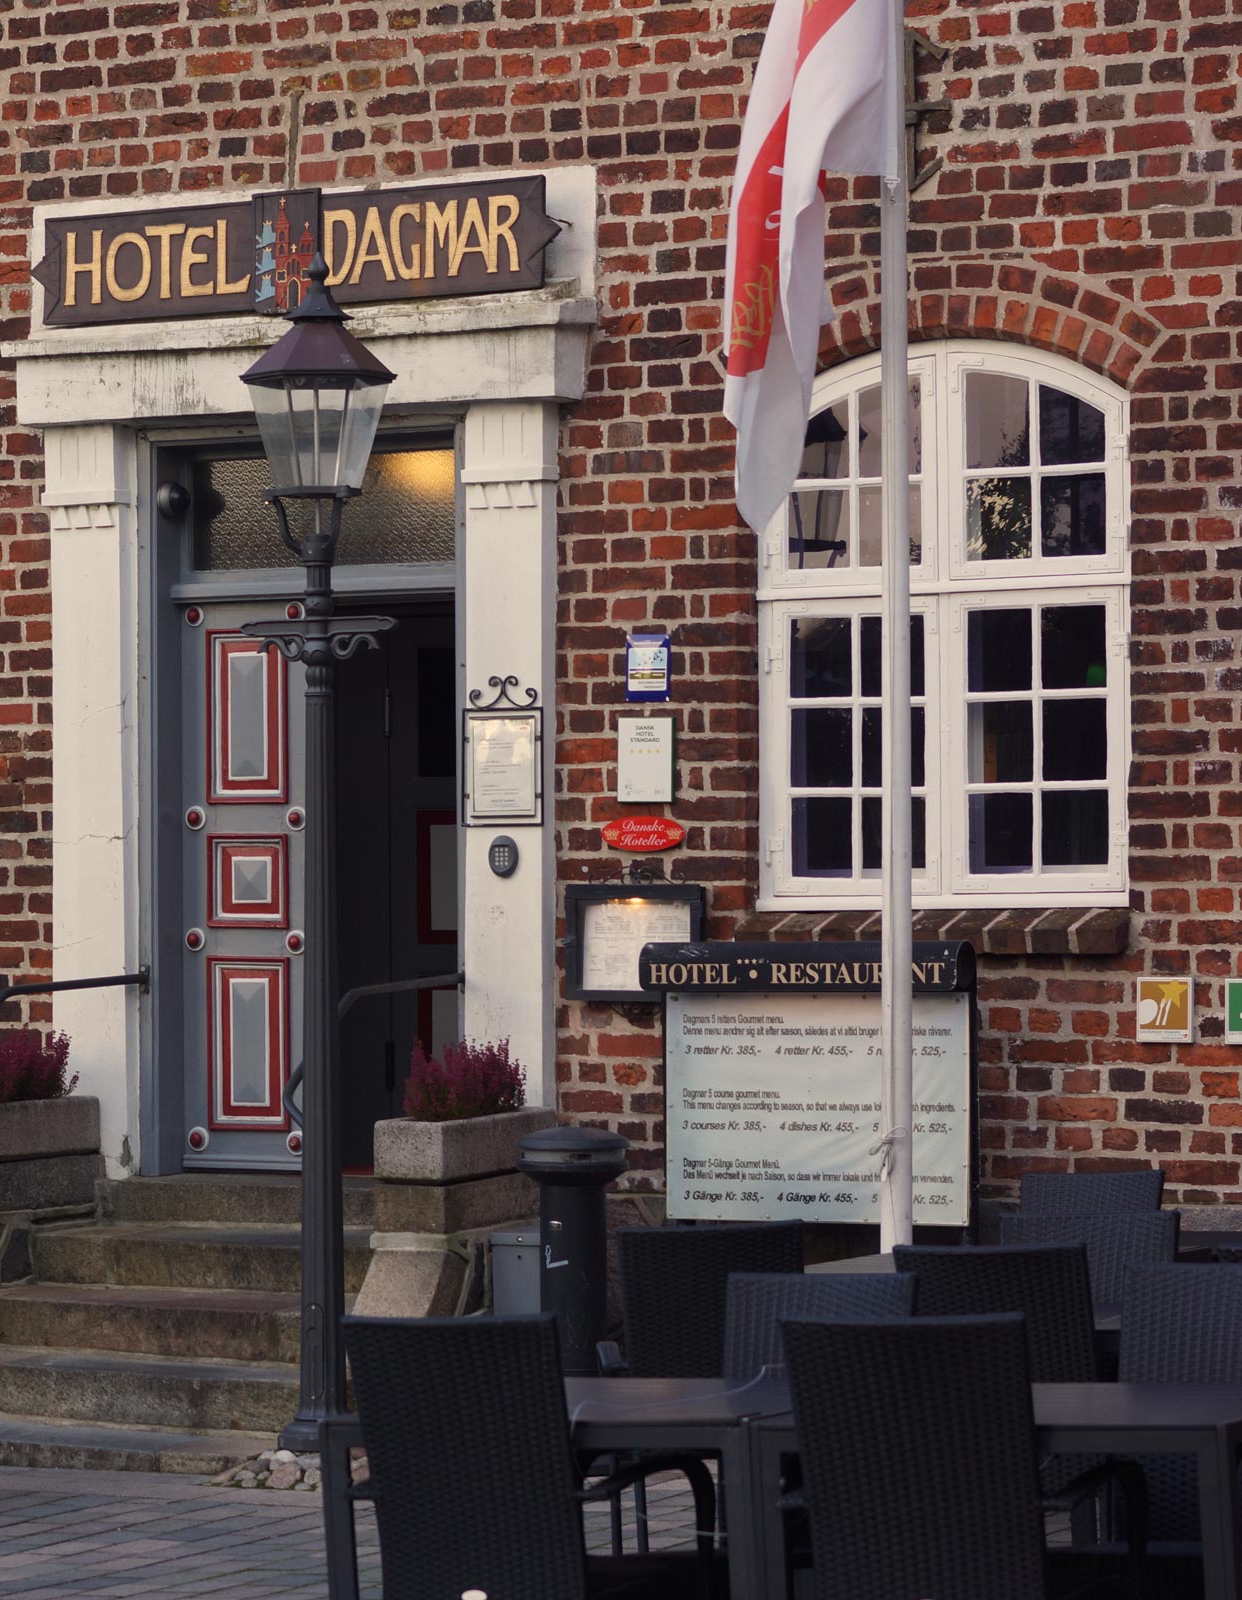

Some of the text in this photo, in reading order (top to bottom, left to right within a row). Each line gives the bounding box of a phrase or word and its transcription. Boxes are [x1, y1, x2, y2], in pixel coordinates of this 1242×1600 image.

[63, 194, 521, 306] HOTEL DAGMAR
[622, 819, 665, 832] Danske
[619, 833, 667, 846] Hoteller
[649, 962, 945, 985] HOTEL RESTAURNT
[682, 1014, 784, 1026] Dagmars 5 retters Gourmet menu.
[683, 1026, 702, 1035] Denne
[704, 1027, 721, 1035] menu
[722, 1026, 745, 1036] ændrer
[746, 1026, 755, 1038] sig
[756, 1026, 764, 1036] alt
[765, 1026, 779, 1036] efter
[781, 1027, 803, 1037] sæson,
[805, 1025, 829, 1036] således
[830, 1026, 837, 1036] at
[837, 1026, 843, 1036] vi
[844, 1026, 857, 1036] altid
[858, 1026, 879, 1038] bruger
[928, 1025, 953, 1036] råvarer.
[685, 1045, 692, 1055] 3
[693, 1045, 719, 1055] retter
[720, 1045, 734, 1055] Kr.
[736, 1045, 761, 1056] 385,-
[775, 1045, 782, 1055] 4
[783, 1046, 810, 1056] retter
[811, 1045, 825, 1056] Kr.
[828, 1046, 853, 1057] 455,-
[867, 1046, 874, 1056] 5
[920, 1046, 947, 1057] 525,-
[682, 1088, 780, 1101] Dagmar 5 course gourmet menu.
[683, 1100, 696, 1110] This
[697, 1101, 714, 1110] menu
[715, 1101, 741, 1112] changes
[742, 1100, 773, 1113] according
[773, 1101, 780, 1111] to
[781, 1102, 805, 1112] season,
[806, 1103, 814, 1111] so
[815, 1101, 828, 1111] that
[828, 1103, 837, 1111] we
[838, 1101, 860, 1114] always
[861, 1103, 872, 1112] use
[920, 1102, 956, 1114] ingredients.
[682, 1120, 953, 1134] 3 courses Kr. 385,- 4 dishes Kr. 455,- 5 Kr. 525,-
[683, 1157, 780, 1170] Dagmar 5-Gänge Gourmet Menü.
[683, 1169, 695, 1179] Das
[696, 1169, 713, 1180] Menü
[714, 1170, 740, 1180] wechselt
[740, 1171, 746, 1182] je
[748, 1170, 763, 1180] nach
[764, 1170, 786, 1182] Saison,
[787, 1173, 795, 1181] so
[796, 1171, 811, 1181] dass
[811, 1171, 821, 1181] wir
[822, 1172, 842, 1182] immer
[842, 1171, 860, 1182] lokale
[861, 1172, 873, 1182] und
[920, 1174, 954, 1184] verwenden.
[684, 1190, 954, 1205] 3 Gänge Kr. 385,- 4 Gänge Kr. 455,- 5 Kr. 525,-
